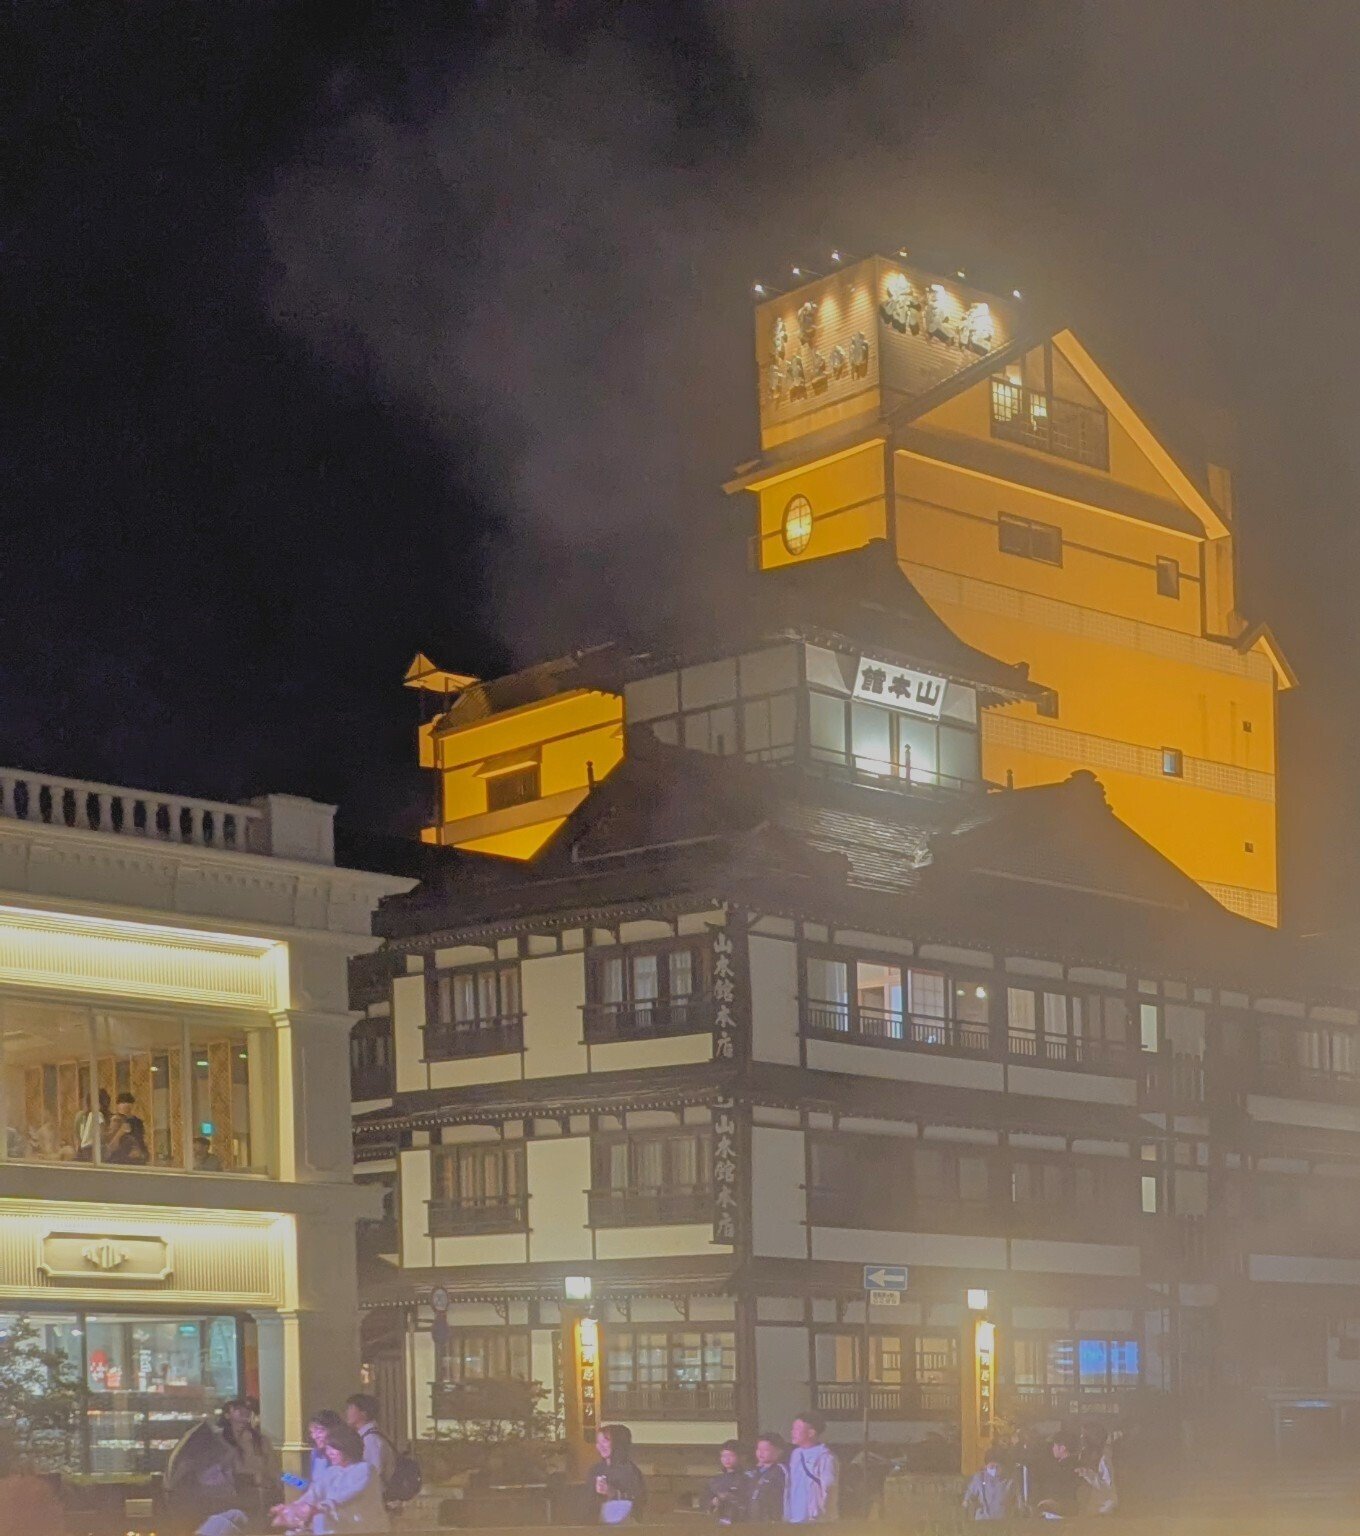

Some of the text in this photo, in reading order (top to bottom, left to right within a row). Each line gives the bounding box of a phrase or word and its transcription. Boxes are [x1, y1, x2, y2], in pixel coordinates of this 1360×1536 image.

[713, 931, 737, 1059] 山本館本店
[714, 1113, 738, 1238] 山本館本店
